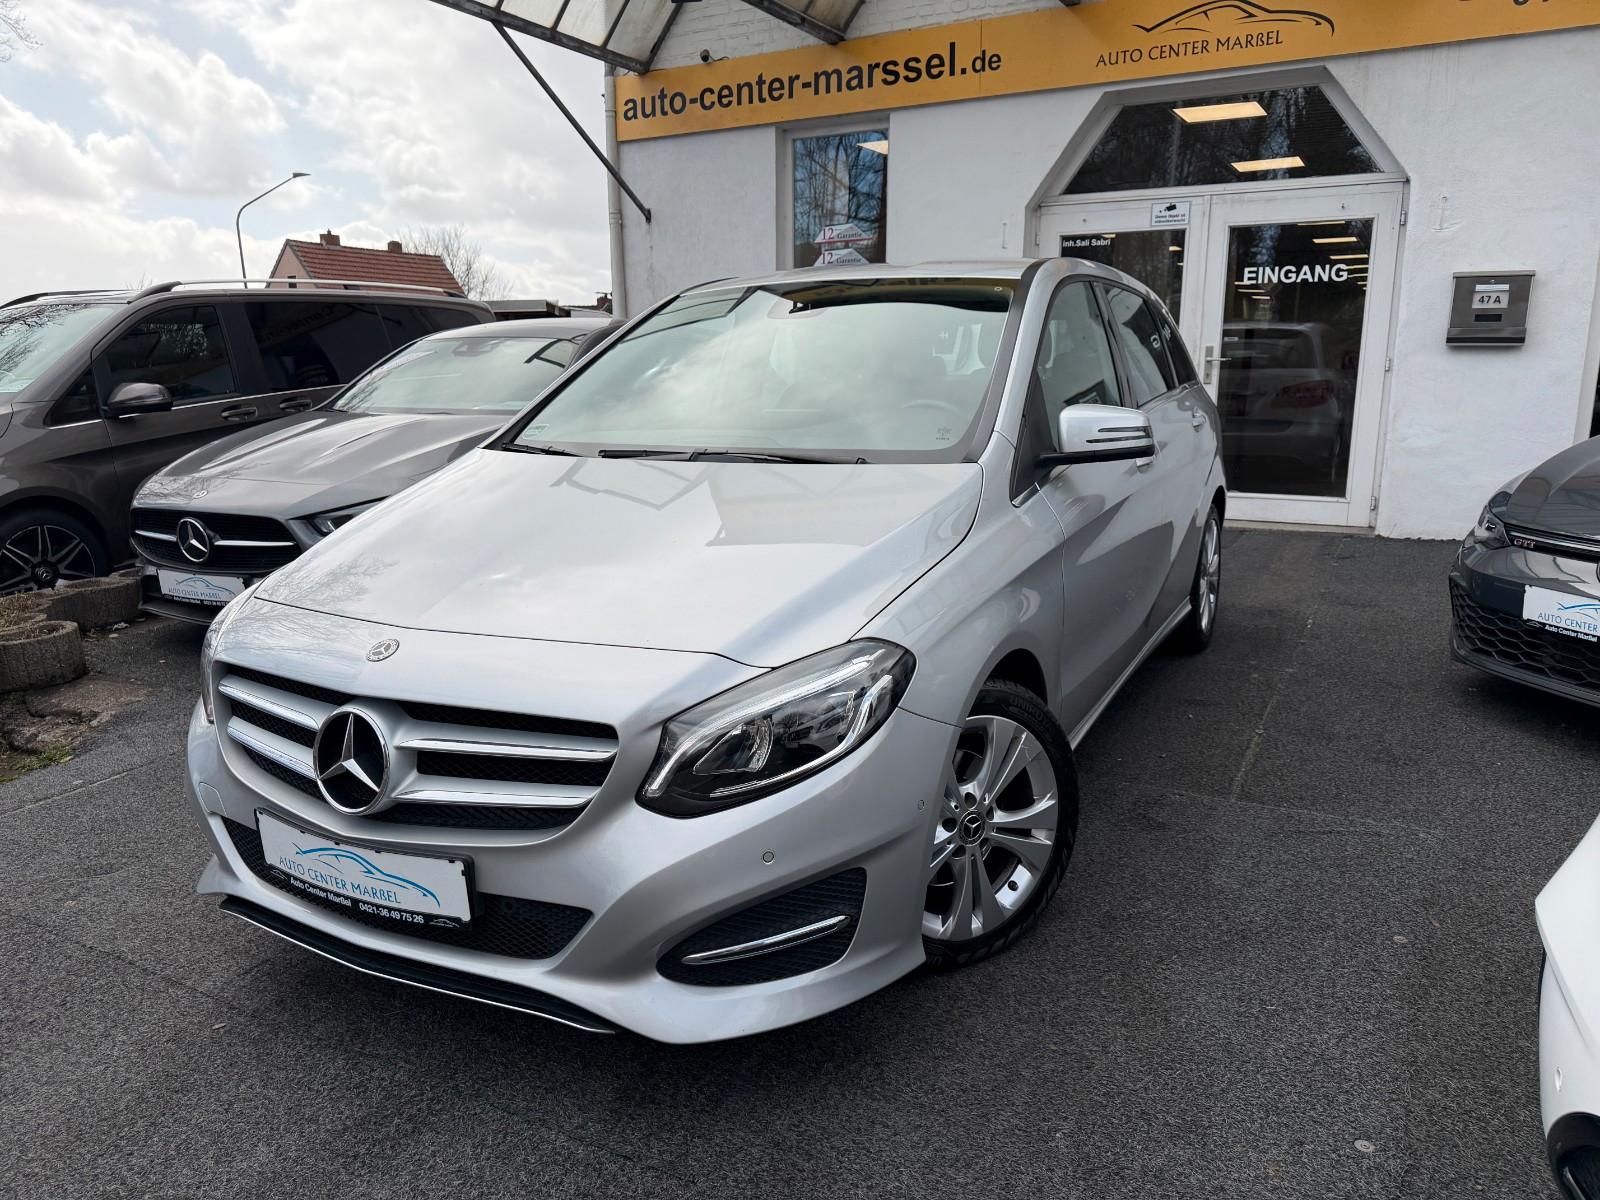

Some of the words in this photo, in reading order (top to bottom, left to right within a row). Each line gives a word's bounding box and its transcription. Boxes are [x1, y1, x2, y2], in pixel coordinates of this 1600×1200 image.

[1096, 49, 1142, 67] AUTO
[1148, 40, 1210, 60] CENTER
[623, 41, 1002, 121] auto-center-marssel.de
[822, 227, 835, 240] 12
[821, 252, 834, 264] 12
[1243, 263, 1348, 284] EINGANG
[1478, 295, 1492, 304] 47
[1493, 295, 1502, 304] A
[1537, 612, 1563, 624] AUTO
[1564, 618, 1598, 633] CENTER
[279, 855, 306, 876] AUTO
[308, 868, 349, 892] CENTER
